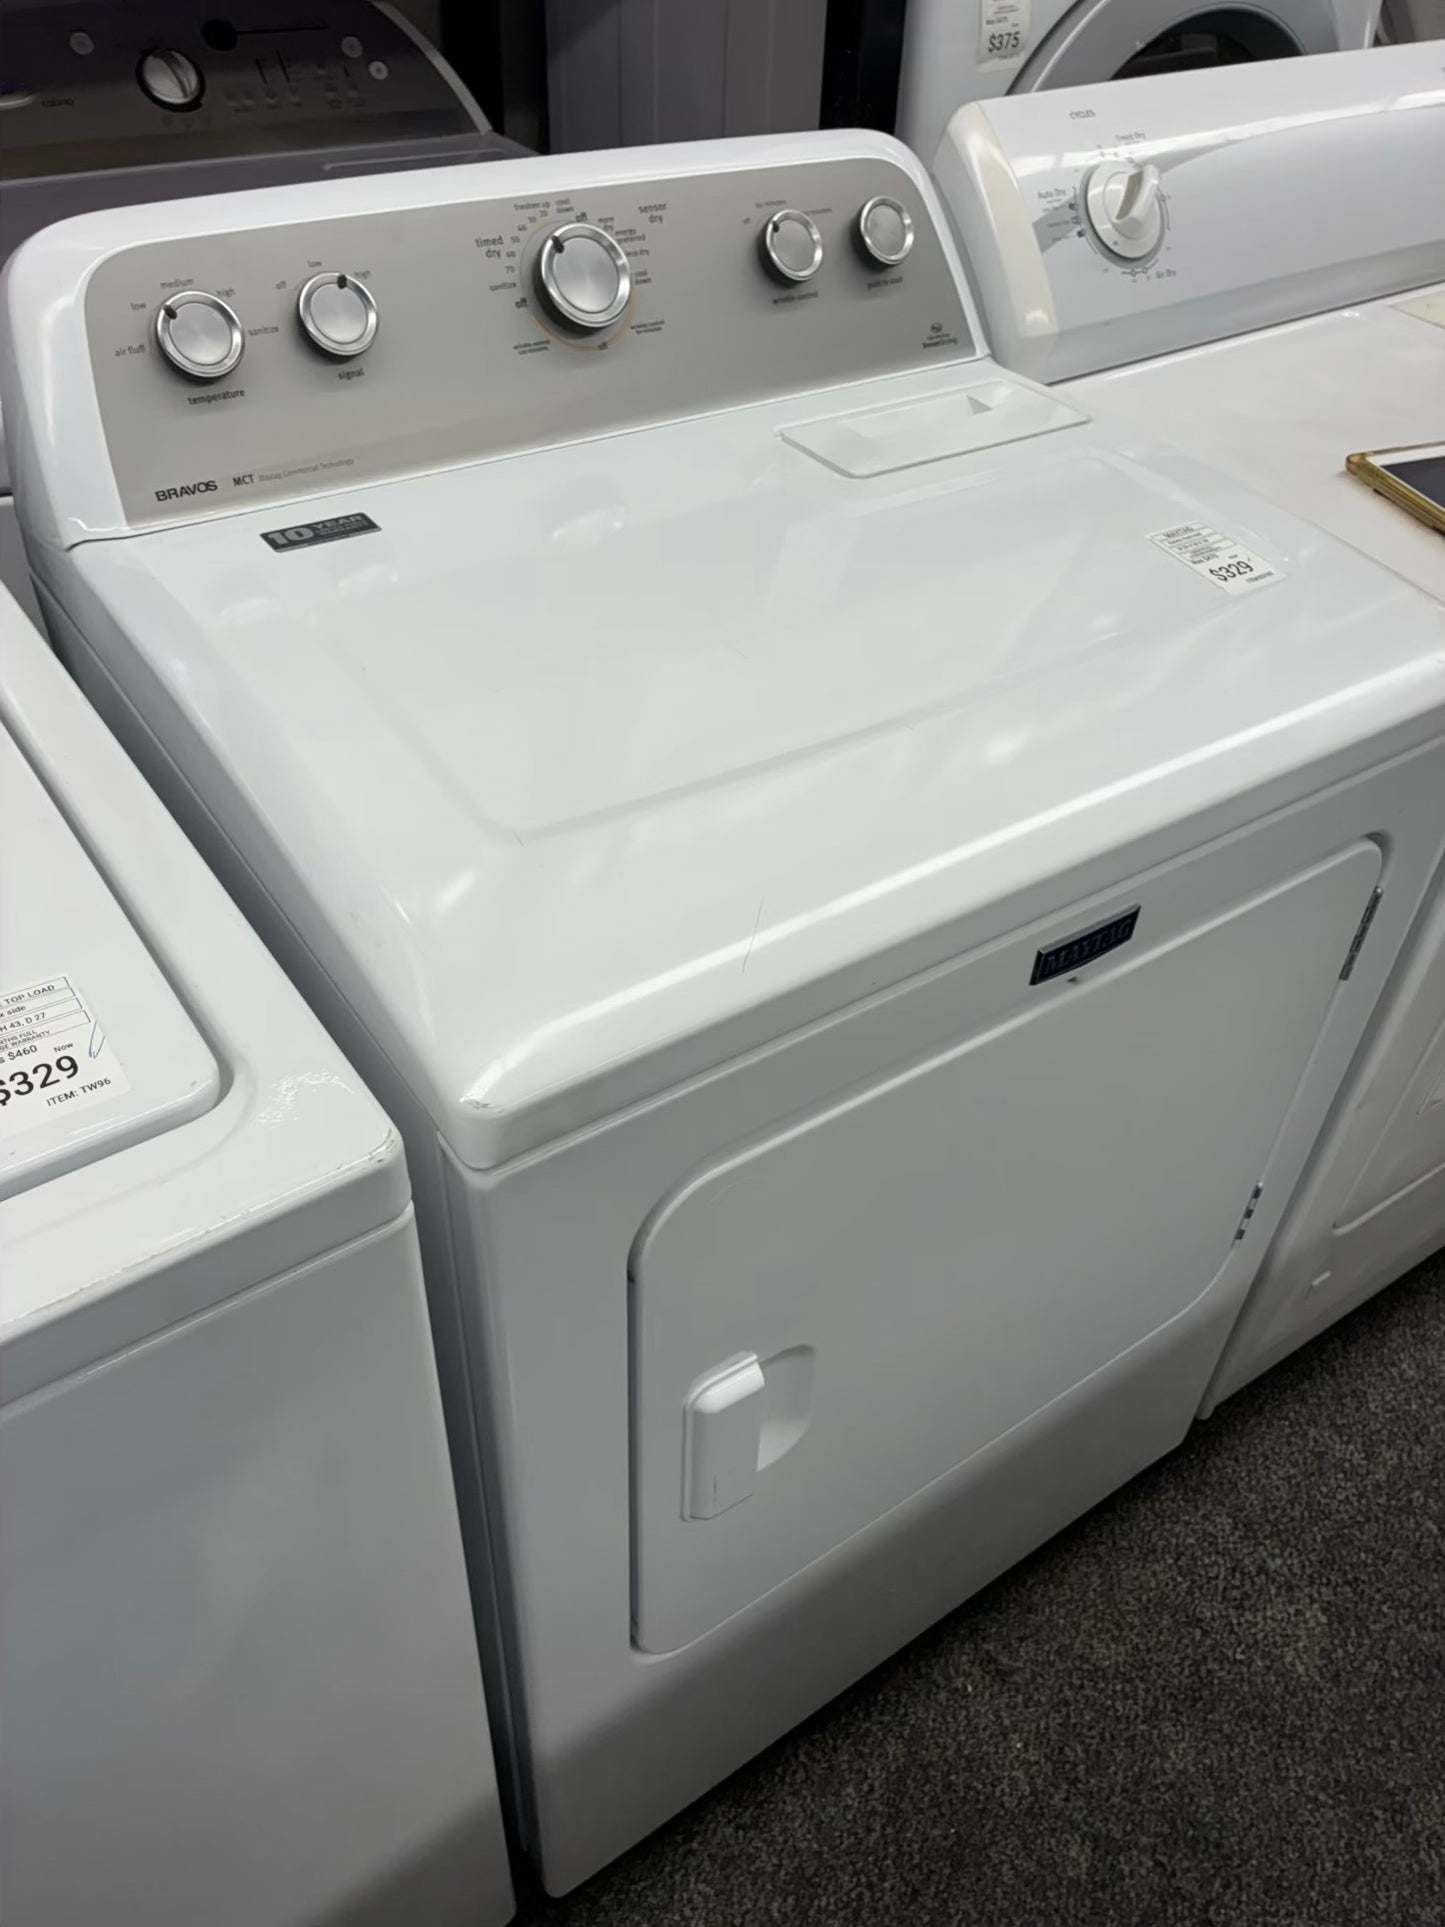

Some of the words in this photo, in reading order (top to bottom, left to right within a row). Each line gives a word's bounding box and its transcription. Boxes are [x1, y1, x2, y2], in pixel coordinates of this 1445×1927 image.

[988, 31, 1020, 53] $375
[638, 203, 667, 214] sensor
[576, 211, 588, 222] off
[649, 214, 664, 224] dry
[475, 235, 504, 248] timed
[485, 248, 501, 260] dry
[308, 260, 322, 268] low
[160, 278, 194, 288] medium
[130, 302, 146, 311] low
[515, 297, 528, 309] off
[248, 326, 280, 336] sanitize
[115, 347, 126, 357] air
[128, 344, 146, 354] fluff
[338, 368, 364, 380] signal
[188, 390, 245, 405] temperature
[154, 480, 218, 502] BRAVOS
[232, 474, 255, 487] MCT
[268, 526, 315, 544] 10
[312, 515, 363, 529] YEAR
[1209, 561, 1254, 582] $329
[1044, 918, 1132, 975] MAYTAG
[4, 994, 25, 1005] TOP
[28, 984, 55, 998] LOAD
[6, 1005, 26, 1016] side
[10, 1020, 24, 1028] 43,
[24, 1016, 32, 1024] D
[34, 1012, 45, 1021] 27
[12, 1030, 50, 1048] WARRANTY
[19, 1030, 38, 1038] FULL
[8, 1044, 38, 1061] $460
[53, 1042, 74, 1053] Now
[46, 1090, 78, 1107] ITEM:
[80, 1077, 112, 1095] TW96
